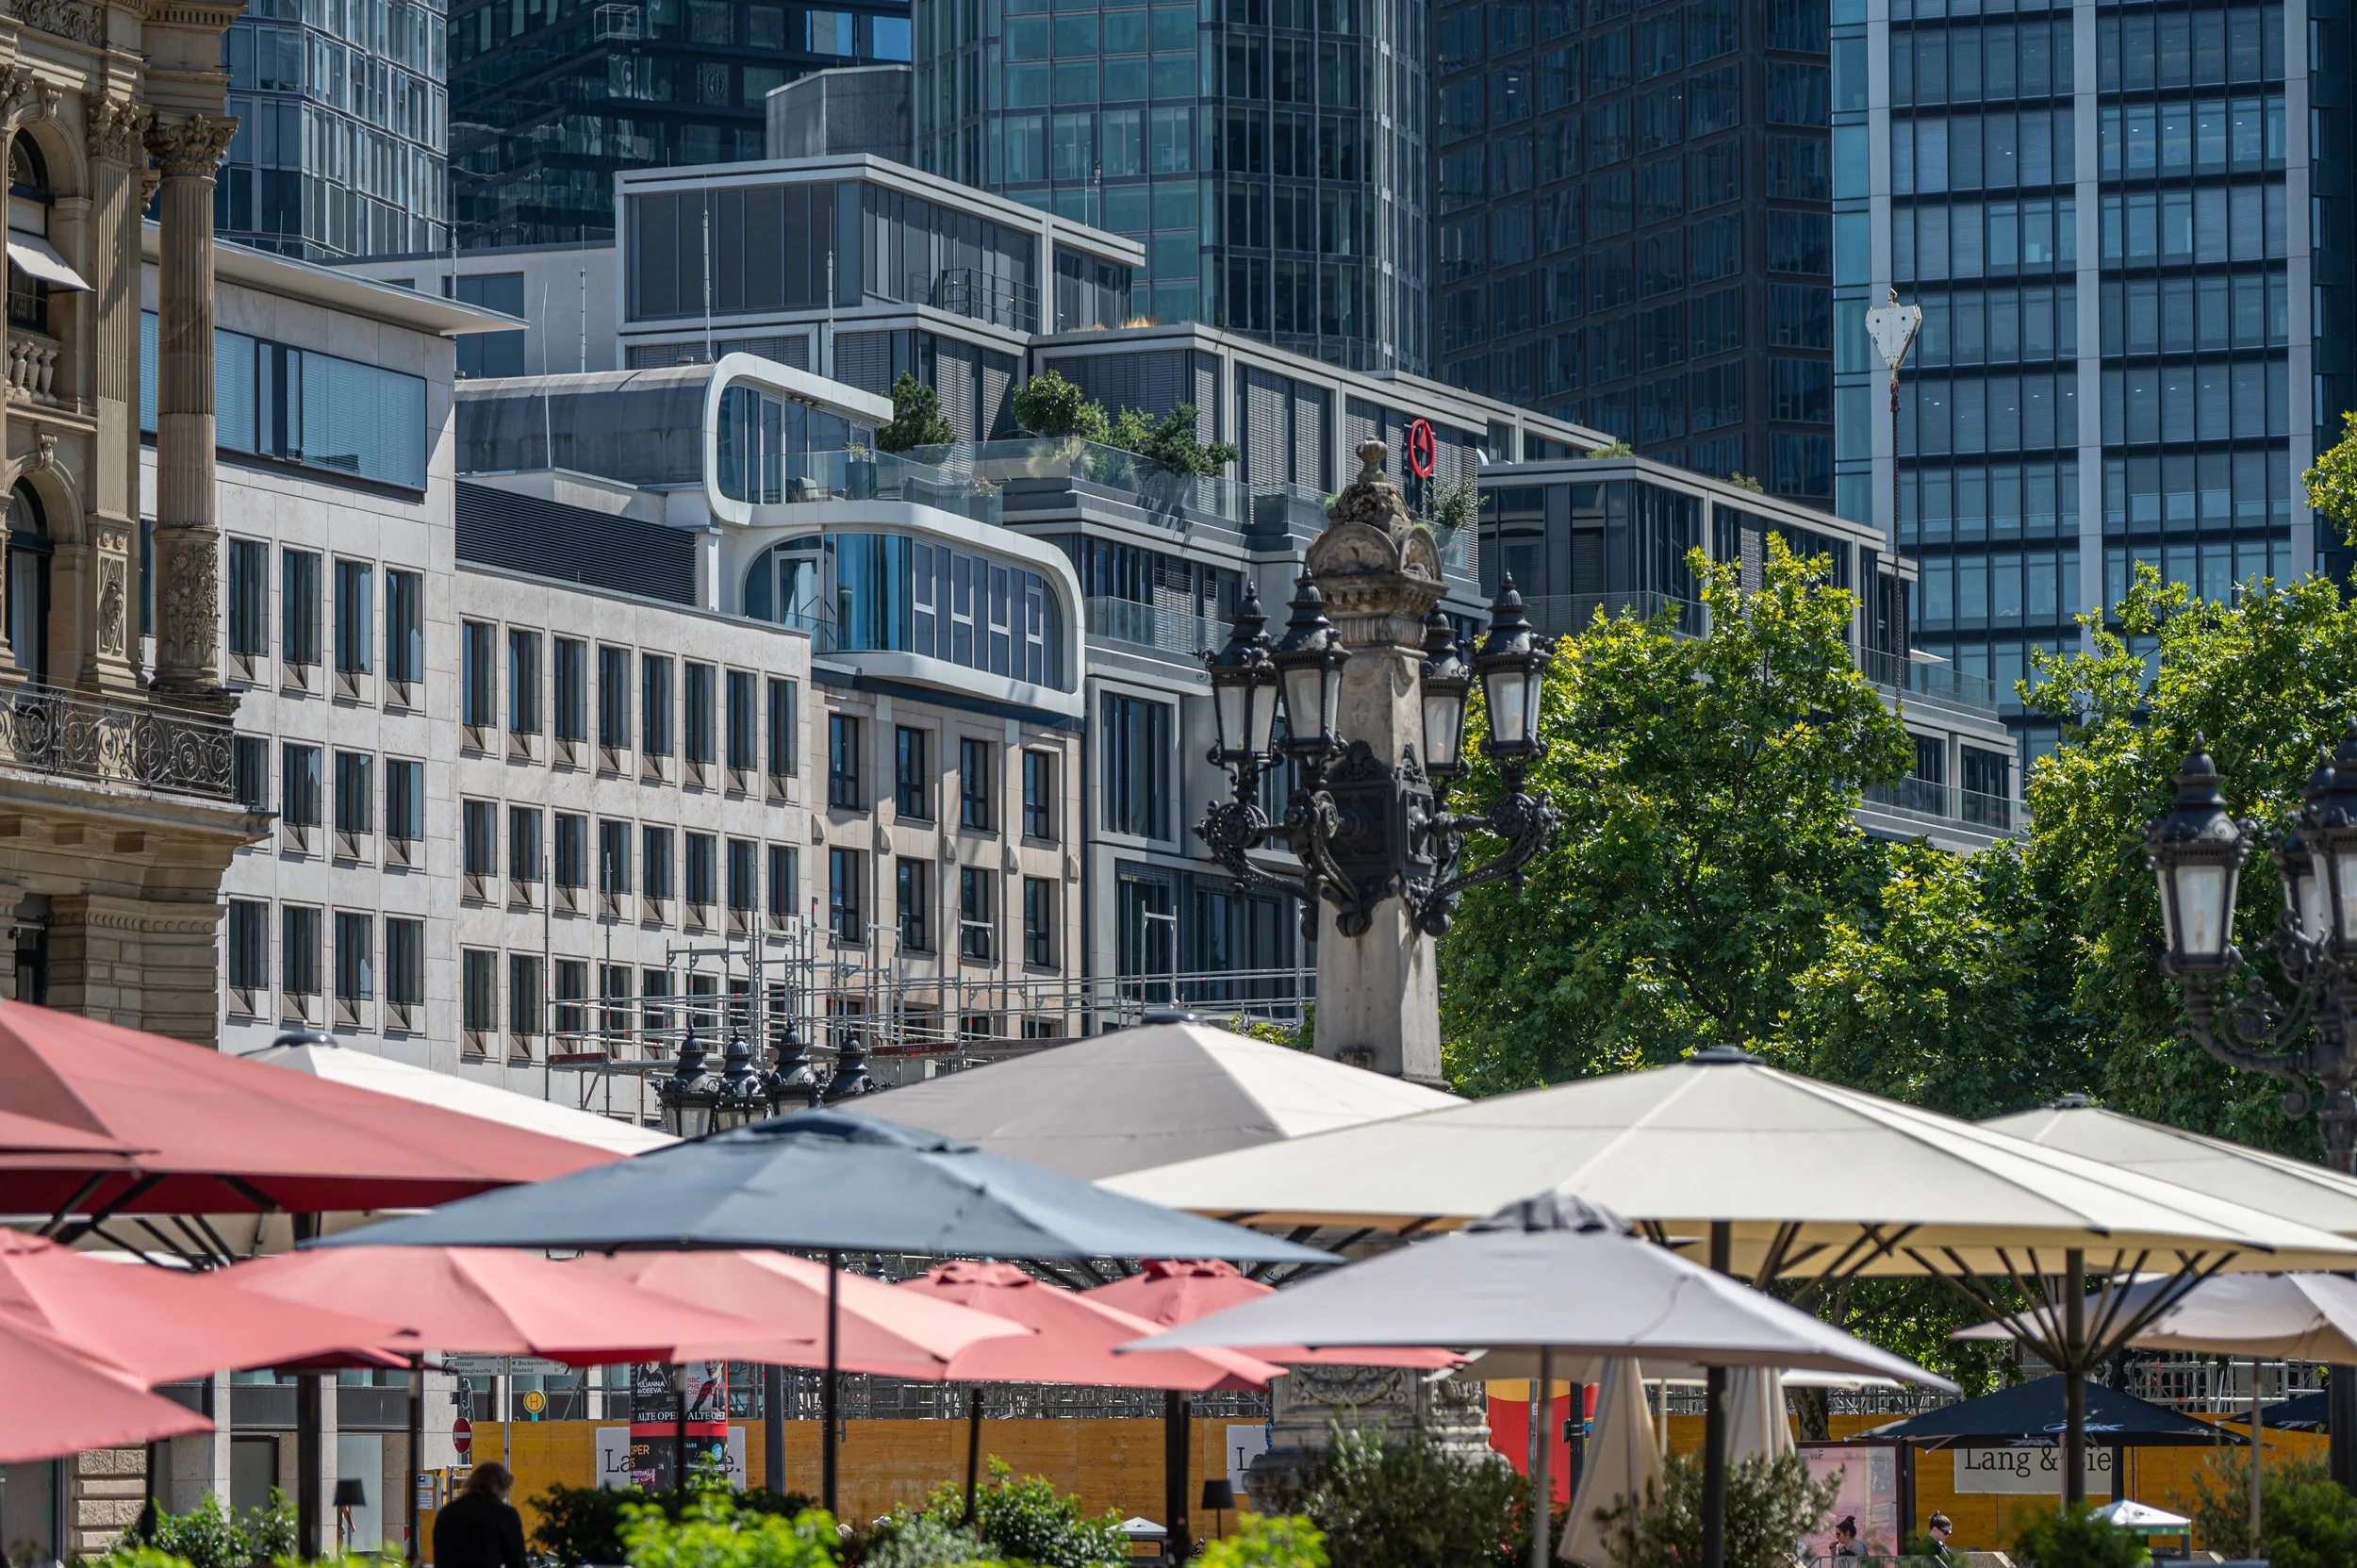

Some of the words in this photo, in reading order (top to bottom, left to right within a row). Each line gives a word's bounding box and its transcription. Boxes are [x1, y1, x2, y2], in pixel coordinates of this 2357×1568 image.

[530, 1395, 538, 1409] H
[637, 1411, 656, 1422] ALTE
[657, 1411, 679, 1421] OPE
[687, 1411, 709, 1421] ALTE
[1965, 1447, 2032, 1478] Lang
[2040, 1446, 2058, 1471] &
